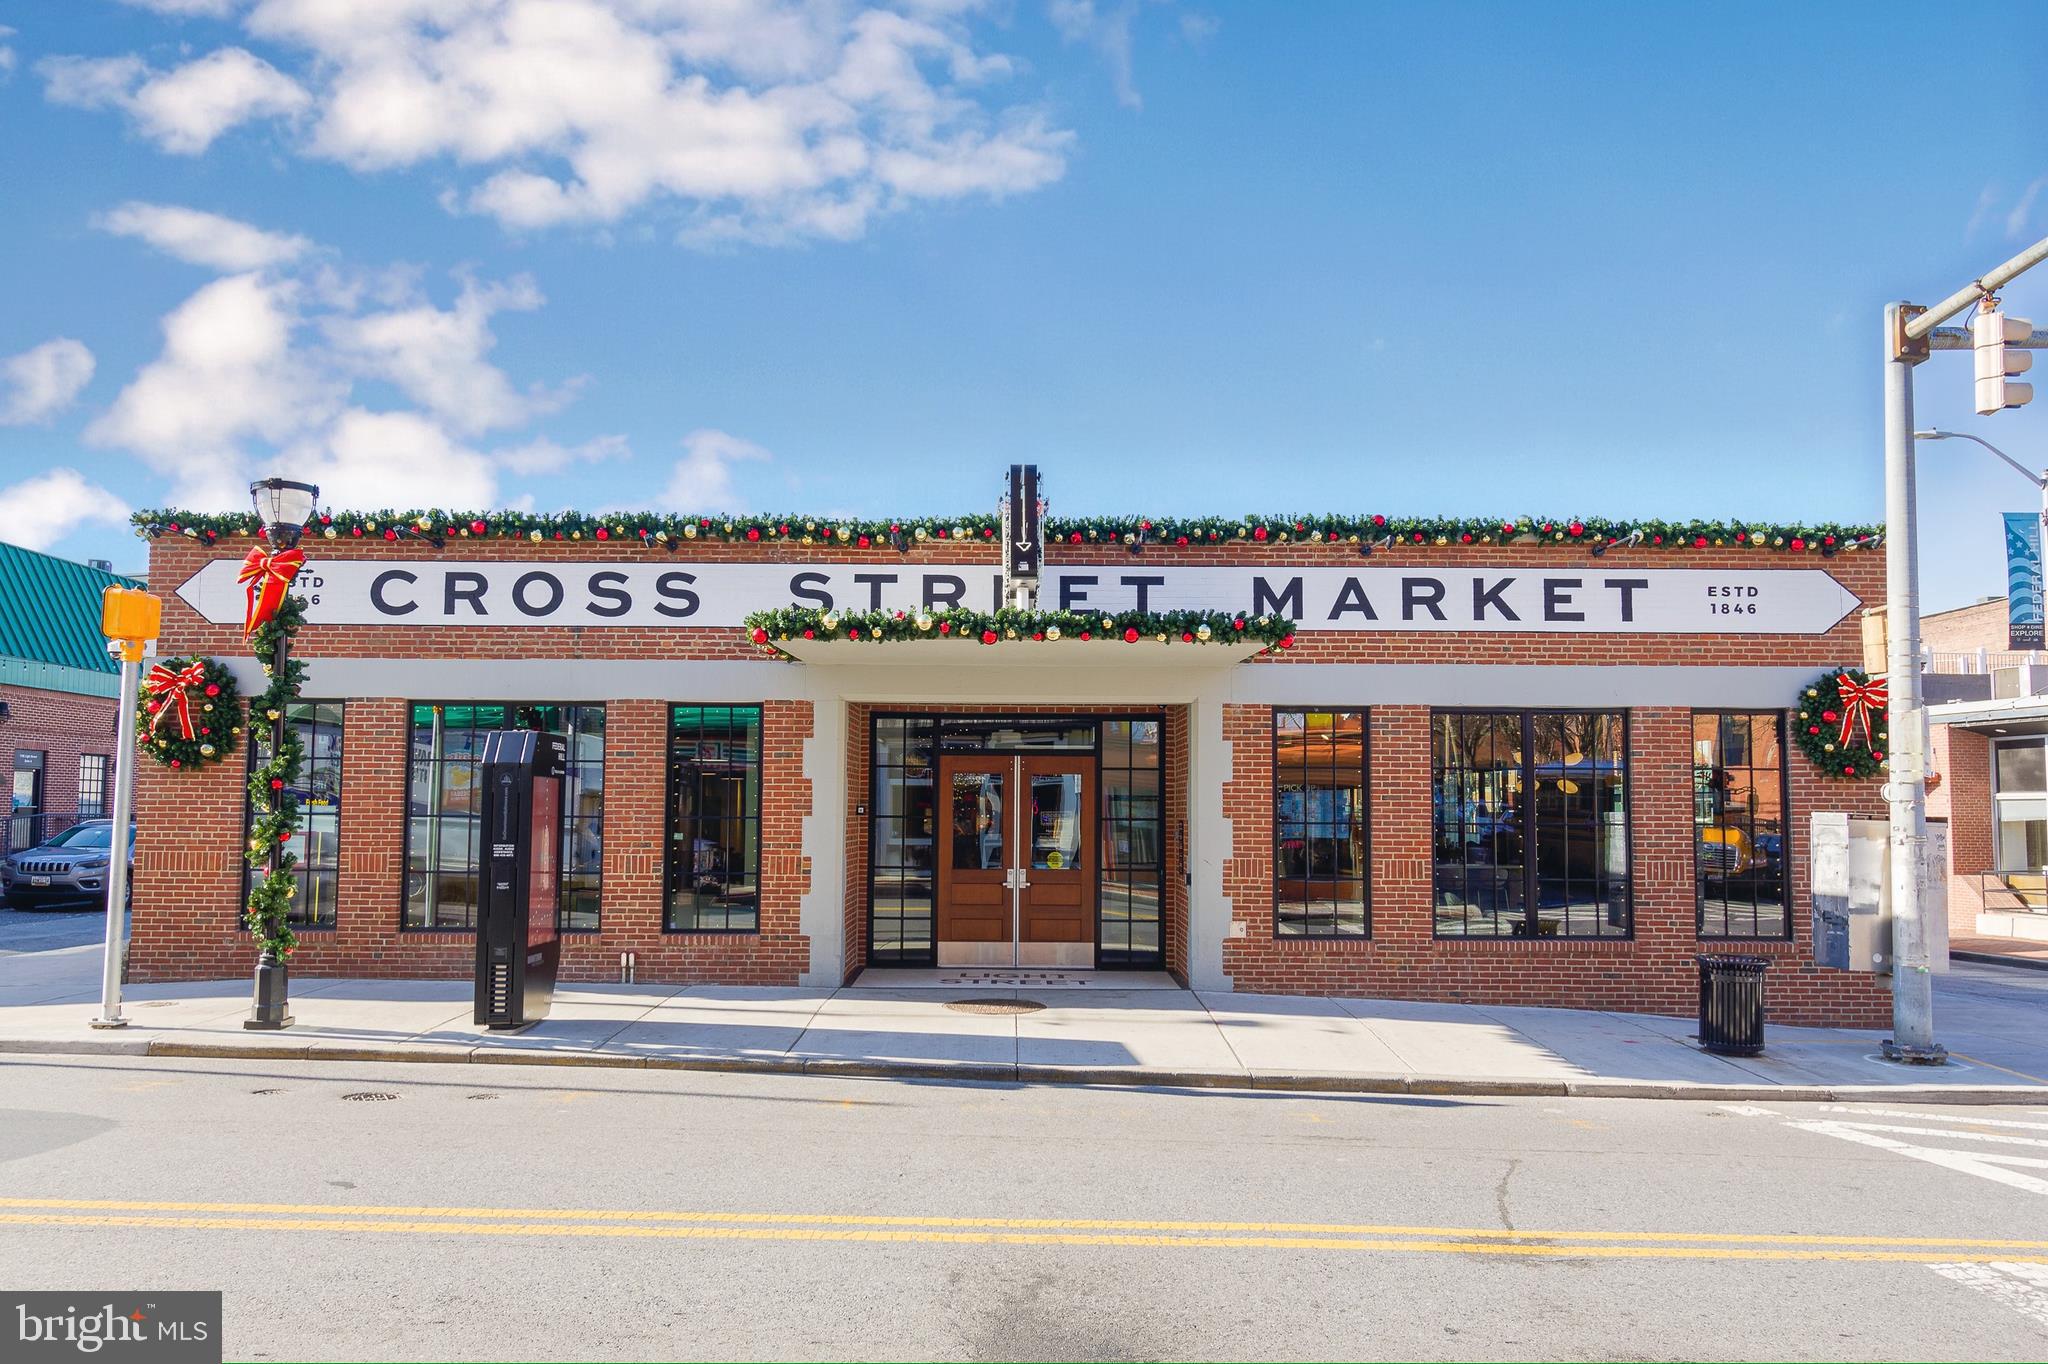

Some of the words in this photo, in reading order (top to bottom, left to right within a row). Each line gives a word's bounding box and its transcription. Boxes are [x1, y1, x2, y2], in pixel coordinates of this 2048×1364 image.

[2028, 522, 2040, 556] HILL
[370, 570, 700, 617] CROSS
[1253, 576, 1649, 622] MARKET
[1707, 586, 1758, 597] ESTD
[2030, 558, 2043, 624] FEDERAL
[1710, 603, 1756, 614] 1846
[1283, 784, 1303, 792] PICK
